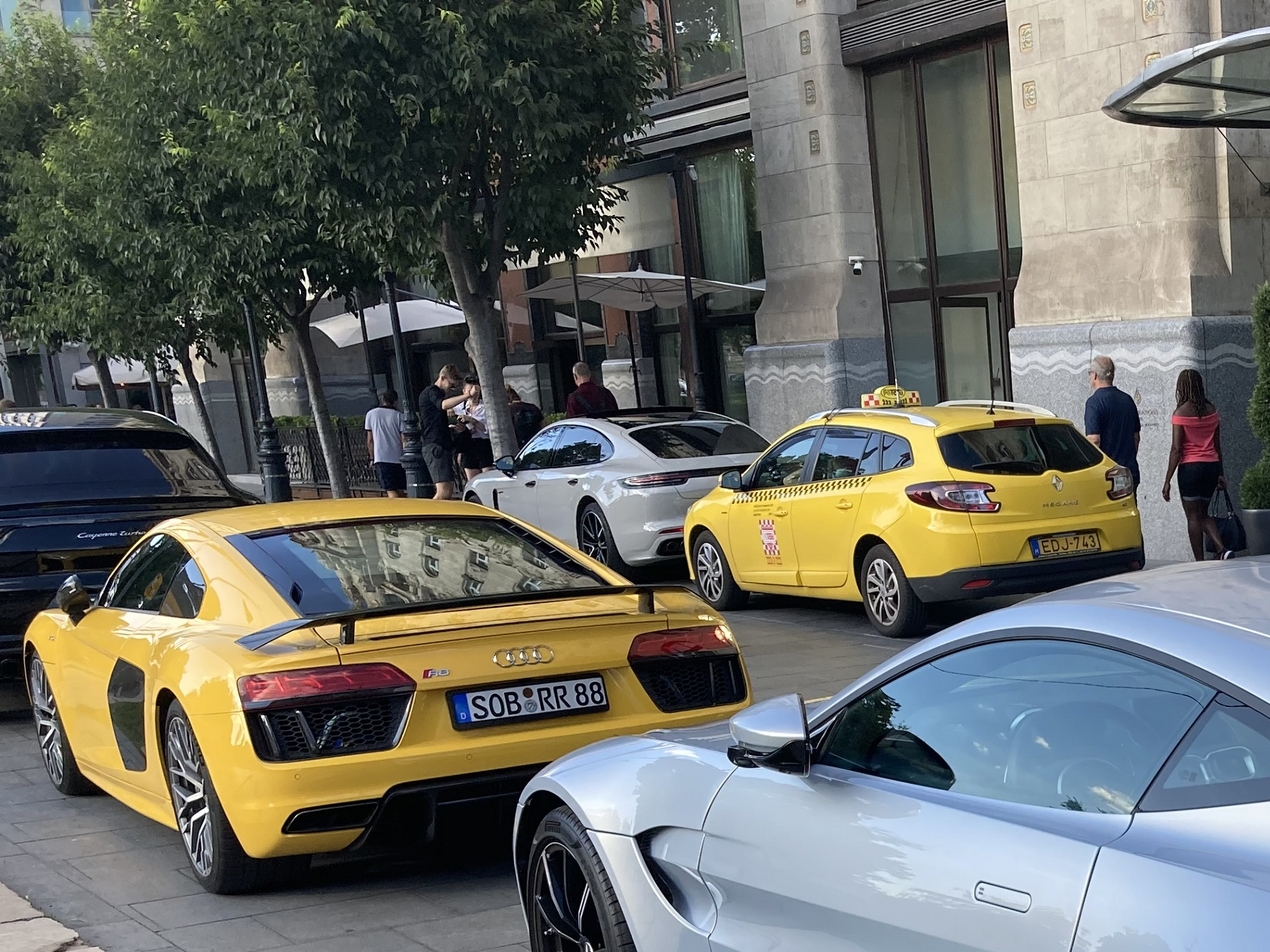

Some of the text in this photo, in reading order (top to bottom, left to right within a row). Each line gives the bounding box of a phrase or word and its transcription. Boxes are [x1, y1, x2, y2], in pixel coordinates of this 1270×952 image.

[77, 531, 118, 540] Cayenne
[1041, 534, 1096, 553] EDJ-743
[459, 681, 605, 720] D SOB RR 88
